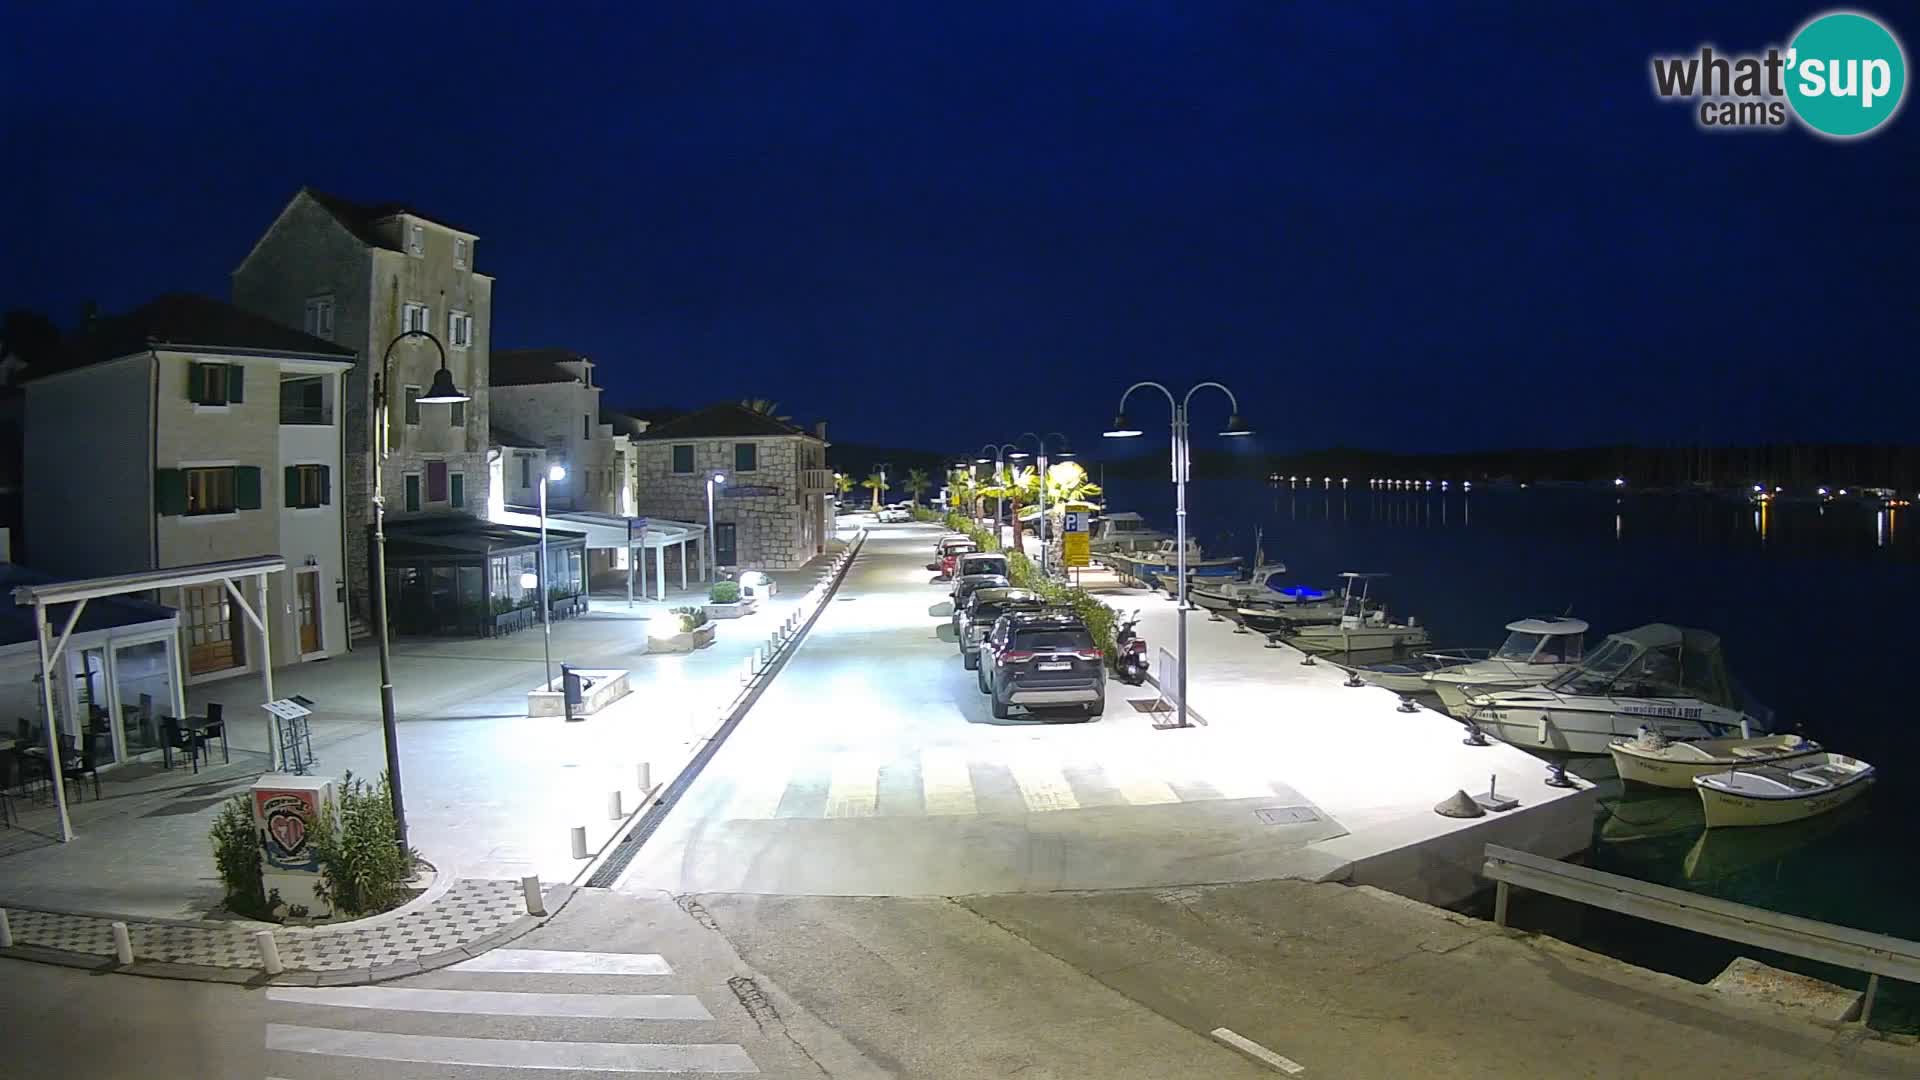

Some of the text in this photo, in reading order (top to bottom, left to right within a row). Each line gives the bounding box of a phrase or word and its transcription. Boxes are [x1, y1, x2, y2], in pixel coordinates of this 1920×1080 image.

[1066, 514, 1076, 530] P
[1657, 706, 1676, 717] RENT
[1684, 707, 1702, 718] BOAT
